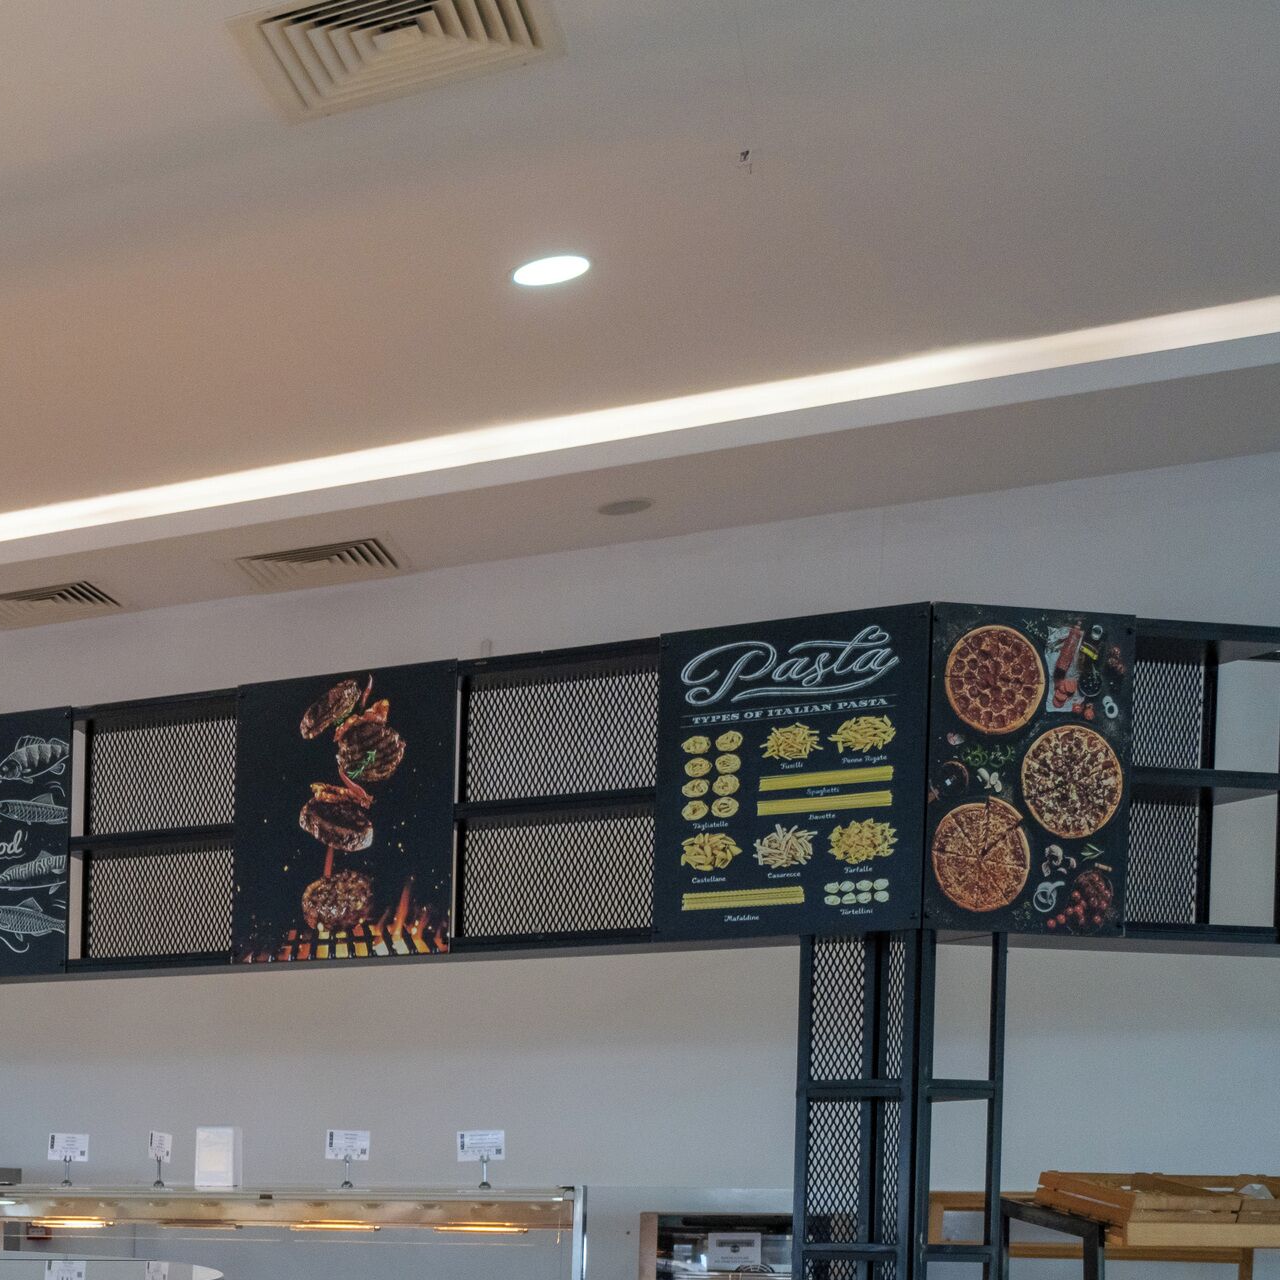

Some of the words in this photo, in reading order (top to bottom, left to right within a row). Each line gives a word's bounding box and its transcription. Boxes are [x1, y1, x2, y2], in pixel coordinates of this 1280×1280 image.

[681, 625, 899, 706] Pasta
[692, 713, 739, 724] TYPES
[744, 709, 762, 719] OF
[767, 703, 831, 716] ITALIAN
[837, 698, 888, 710] PASTA
